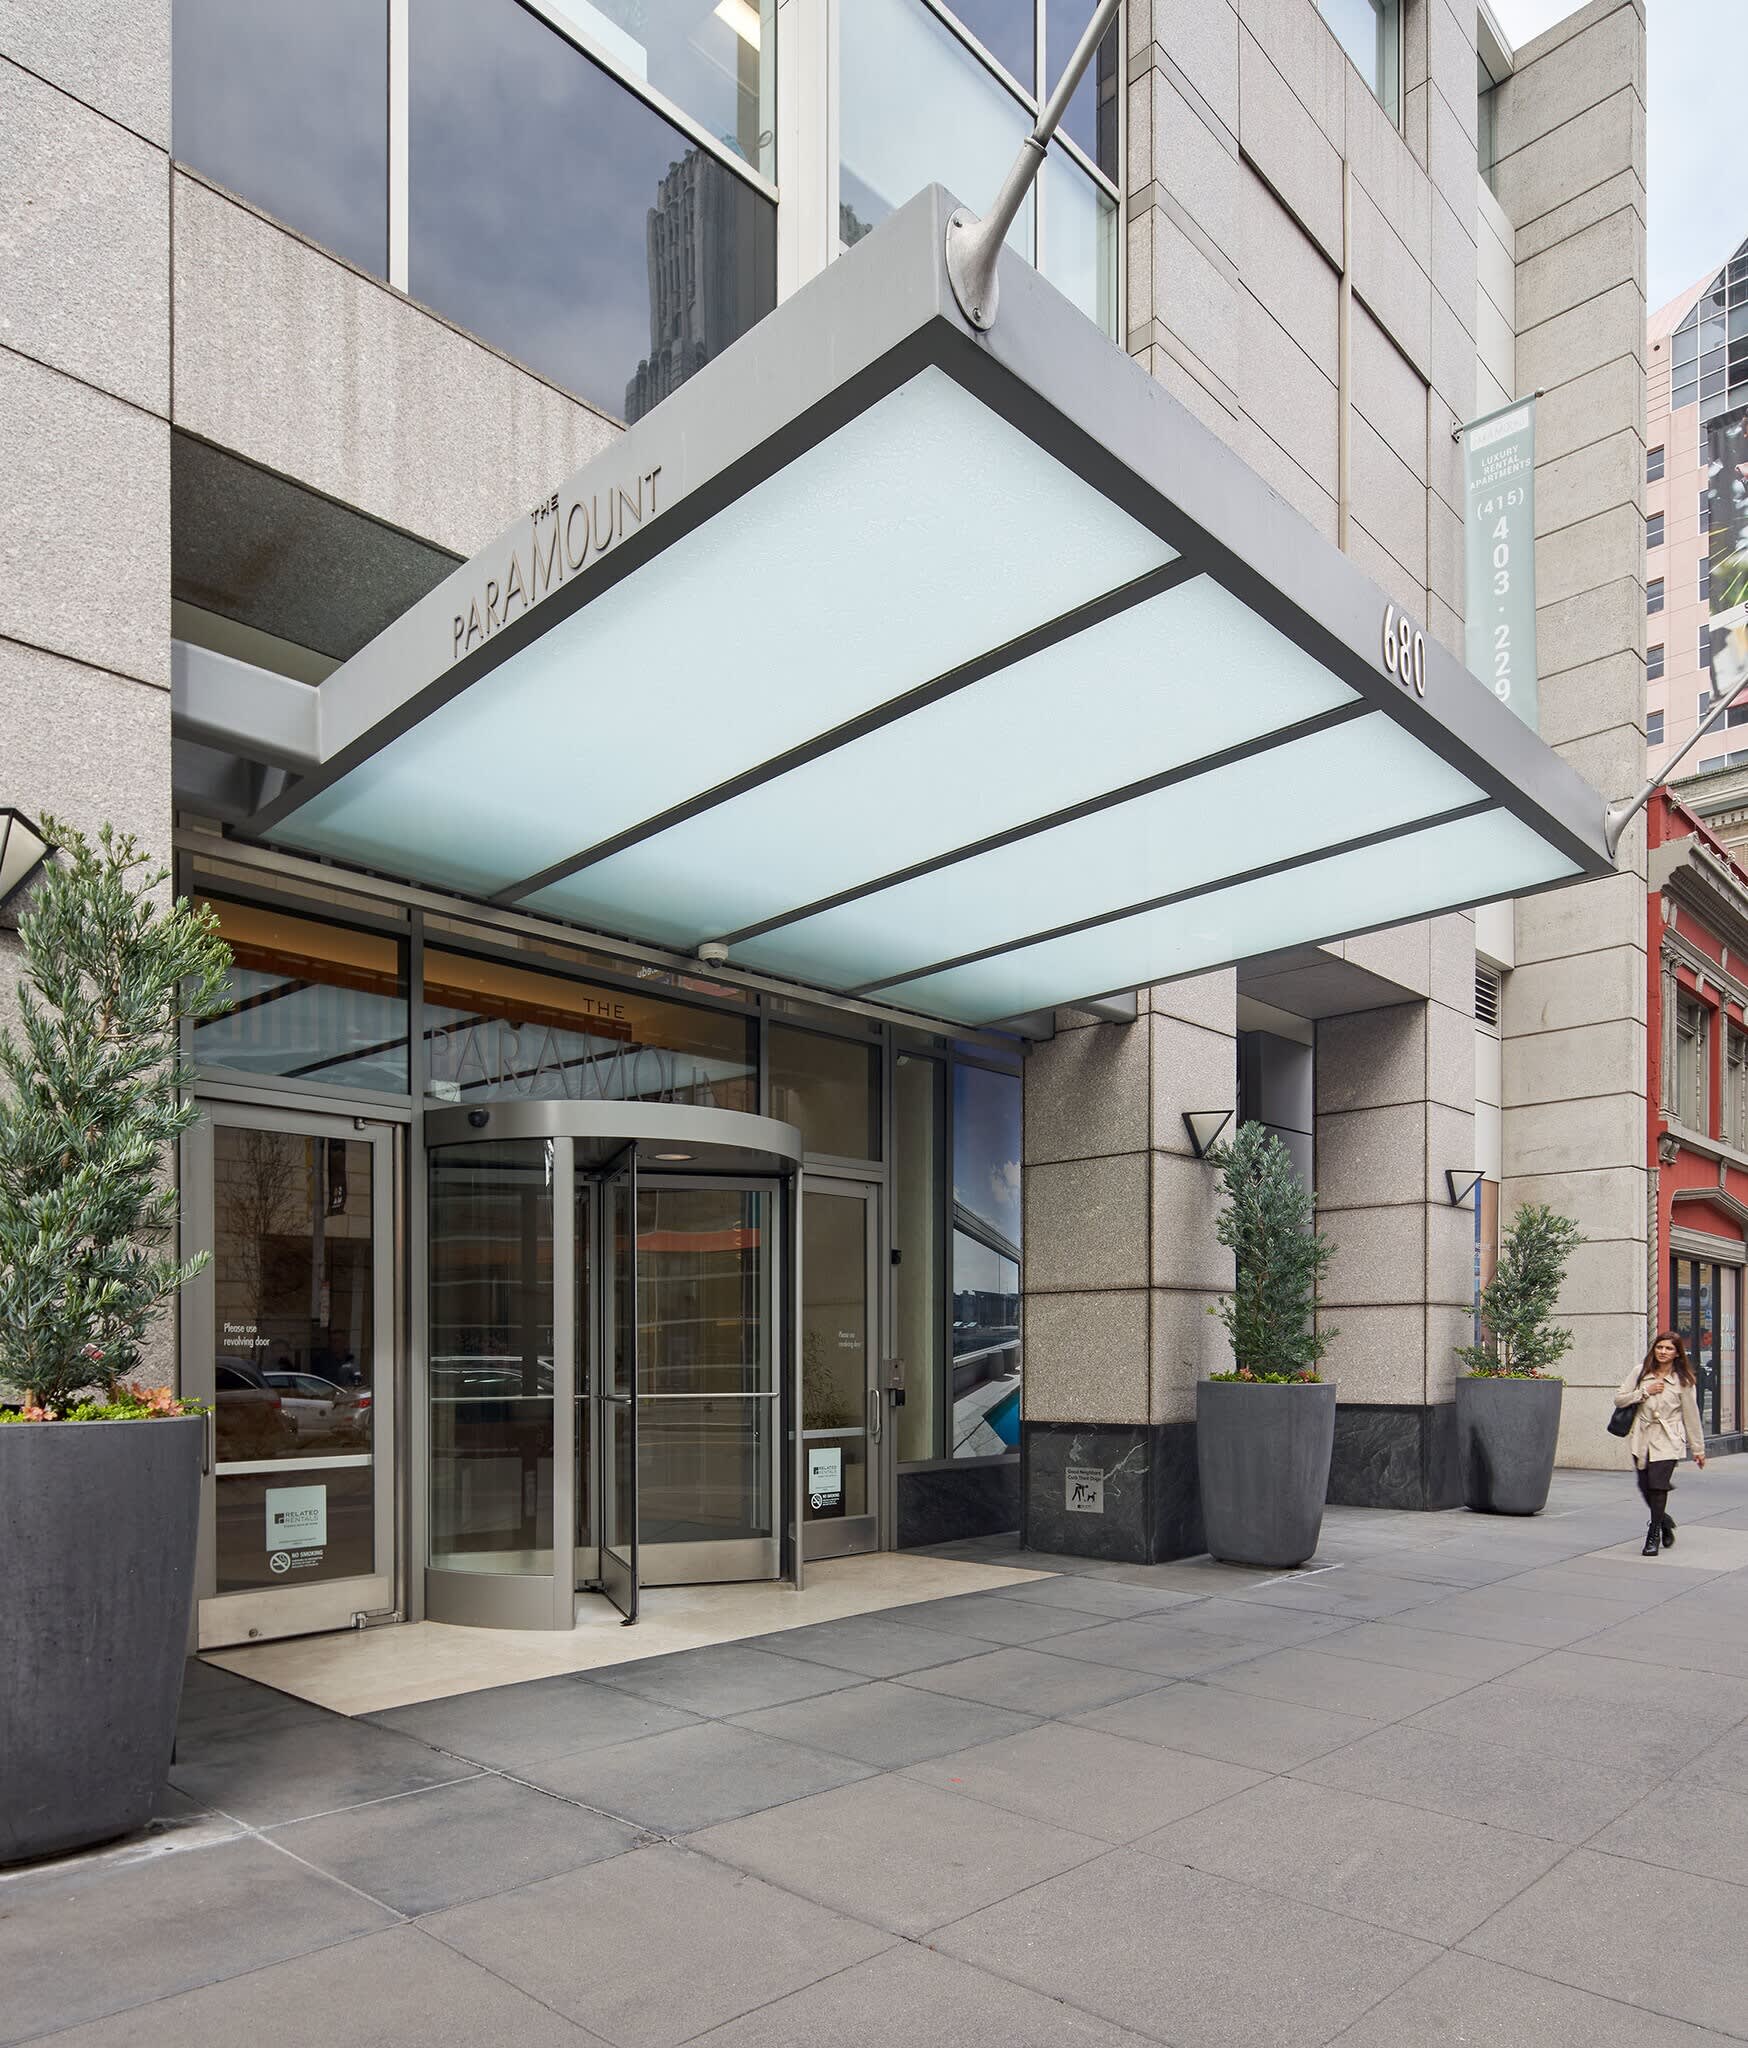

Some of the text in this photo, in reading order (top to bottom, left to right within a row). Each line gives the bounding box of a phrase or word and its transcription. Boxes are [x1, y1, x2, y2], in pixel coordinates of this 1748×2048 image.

[1481, 444, 1521, 468] LUXURY
[1483, 455, 1520, 476] RENTAL
[1470, 457, 1532, 491] APARTMENTS
[530, 492, 559, 525] THE
[1477, 487, 1525, 521] (415)
[453, 465, 662, 659] PARAMOUNT
[1383, 603, 1426, 697] 680
[584, 998, 625, 1020] THE
[224, 1322, 245, 1332] Please
[224, 1335, 270, 1348] revolving door
[285, 1509, 319, 1517] RELATED
